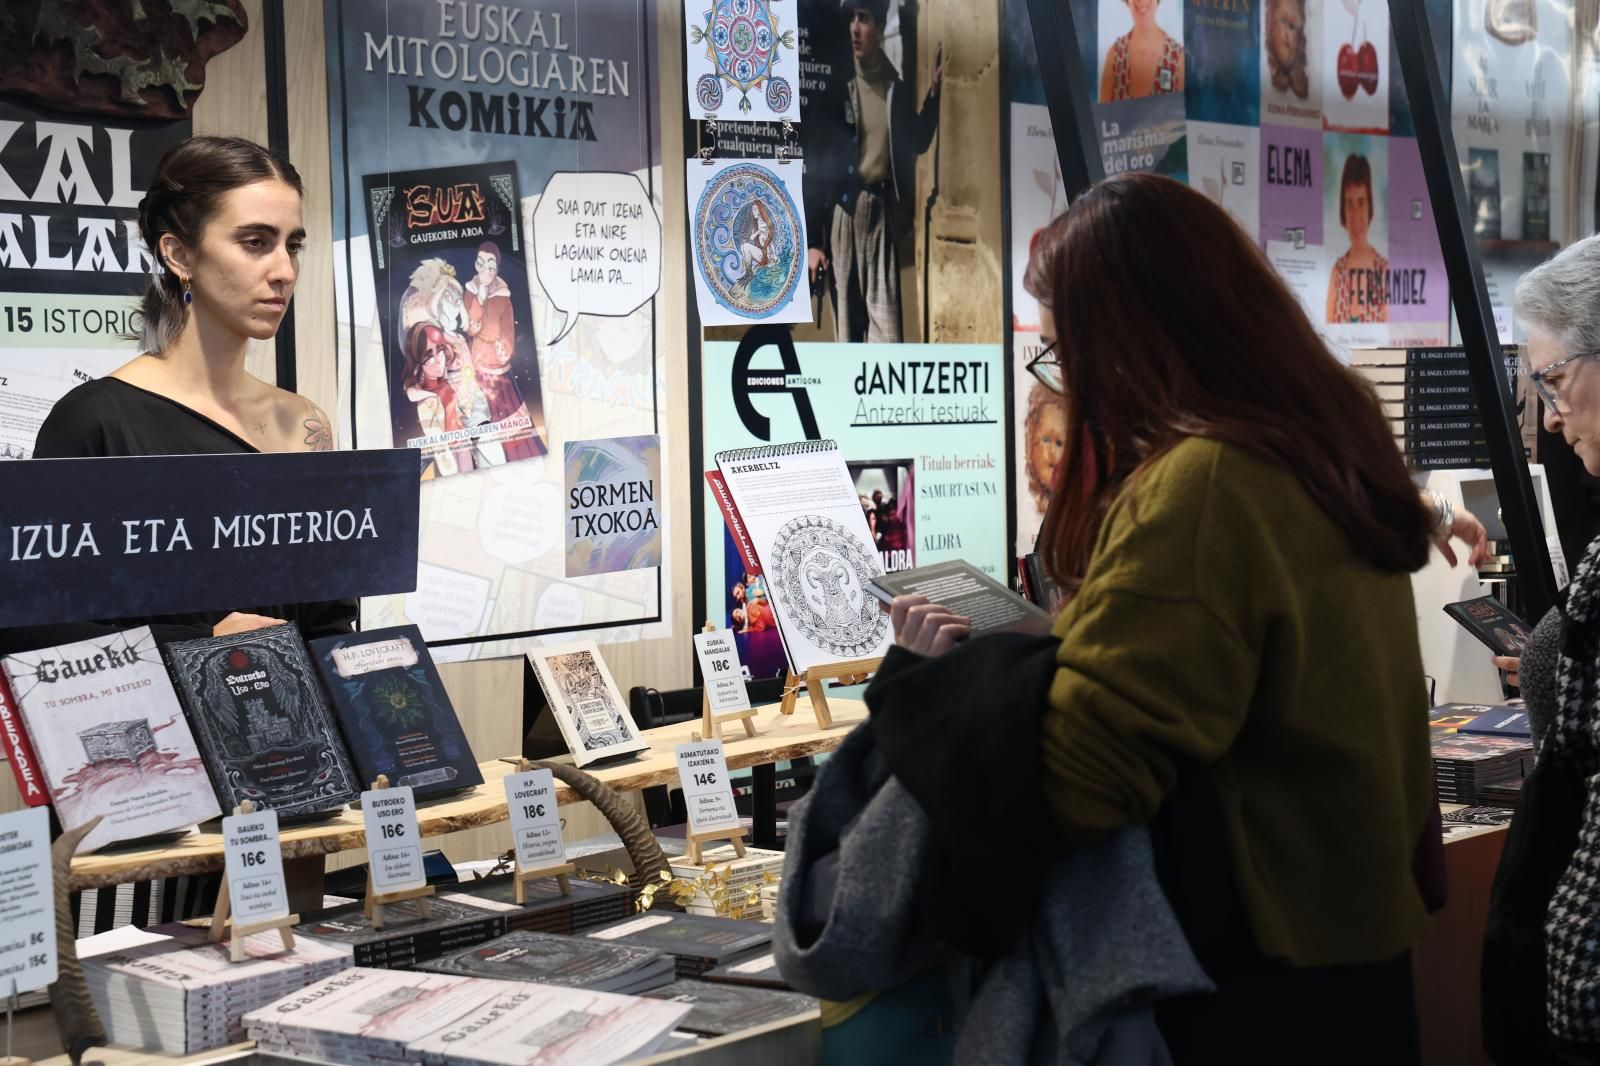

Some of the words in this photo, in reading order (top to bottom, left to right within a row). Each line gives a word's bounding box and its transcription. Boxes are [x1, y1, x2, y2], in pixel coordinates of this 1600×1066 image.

[438, 0, 568, 50] EUSKAL
[364, 32, 630, 97] MITOLOGIAREN
[1102, 121, 1120, 138] La
[717, 136, 773, 157] cualquiera
[1103, 133, 1166, 155] marisma
[1104, 154, 1128, 174] del
[1130, 153, 1154, 170] oro
[1267, 144, 1312, 187] ELENA
[403, 184, 486, 230] SUA
[557, 200, 579, 216] SUA
[584, 201, 605, 217] DUT
[612, 202, 643, 218] IZENA
[411, 229, 458, 244] GAUEKOREN
[461, 227, 483, 239] AROA
[575, 224, 597, 239] ETA
[600, 225, 627, 240] NIRE
[555, 244, 605, 260] LAGUNIK
[609, 248, 648, 263] ONENA
[570, 269, 604, 283] LAMIA
[4, 306, 33, 333] 15
[747, 377, 784, 386] EDICIONES
[854, 361, 989, 395] dANTZERTI
[854, 398, 924, 424] Antzerki
[930, 397, 989, 423] testuak
[440, 425, 499, 442] MITOLOGIAREN
[500, 419, 530, 431] MANGA
[730, 461, 781, 474] AKERBELTZ
[920, 455, 951, 471] Titulu
[570, 480, 654, 509] SORMEN
[921, 481, 997, 499] SAMURTASUNA
[571, 508, 658, 537] TXOKOA
[10, 522, 101, 560] IZUA
[122, 518, 193, 555] ETA
[212, 508, 379, 548] MISTERIOA
[923, 533, 962, 551] ALDRA
[704, 646, 731, 656] MANDALAK
[706, 639, 725, 647] EUSKAL
[36, 644, 140, 684] Gaueko
[711, 659, 730, 672] 18€
[680, 748, 719, 759] ASMATUTAKO
[693, 772, 717, 787] 14€
[514, 788, 548, 799] LOVECRAFT
[372, 797, 406, 808] BUTROEKO
[391, 808, 404, 816] ERO
[523, 804, 546, 819] 18€
[237, 823, 265, 834] GAUEKO
[381, 823, 405, 839] 16€
[230, 838, 239, 846] TU
[241, 850, 266, 867] 16€
